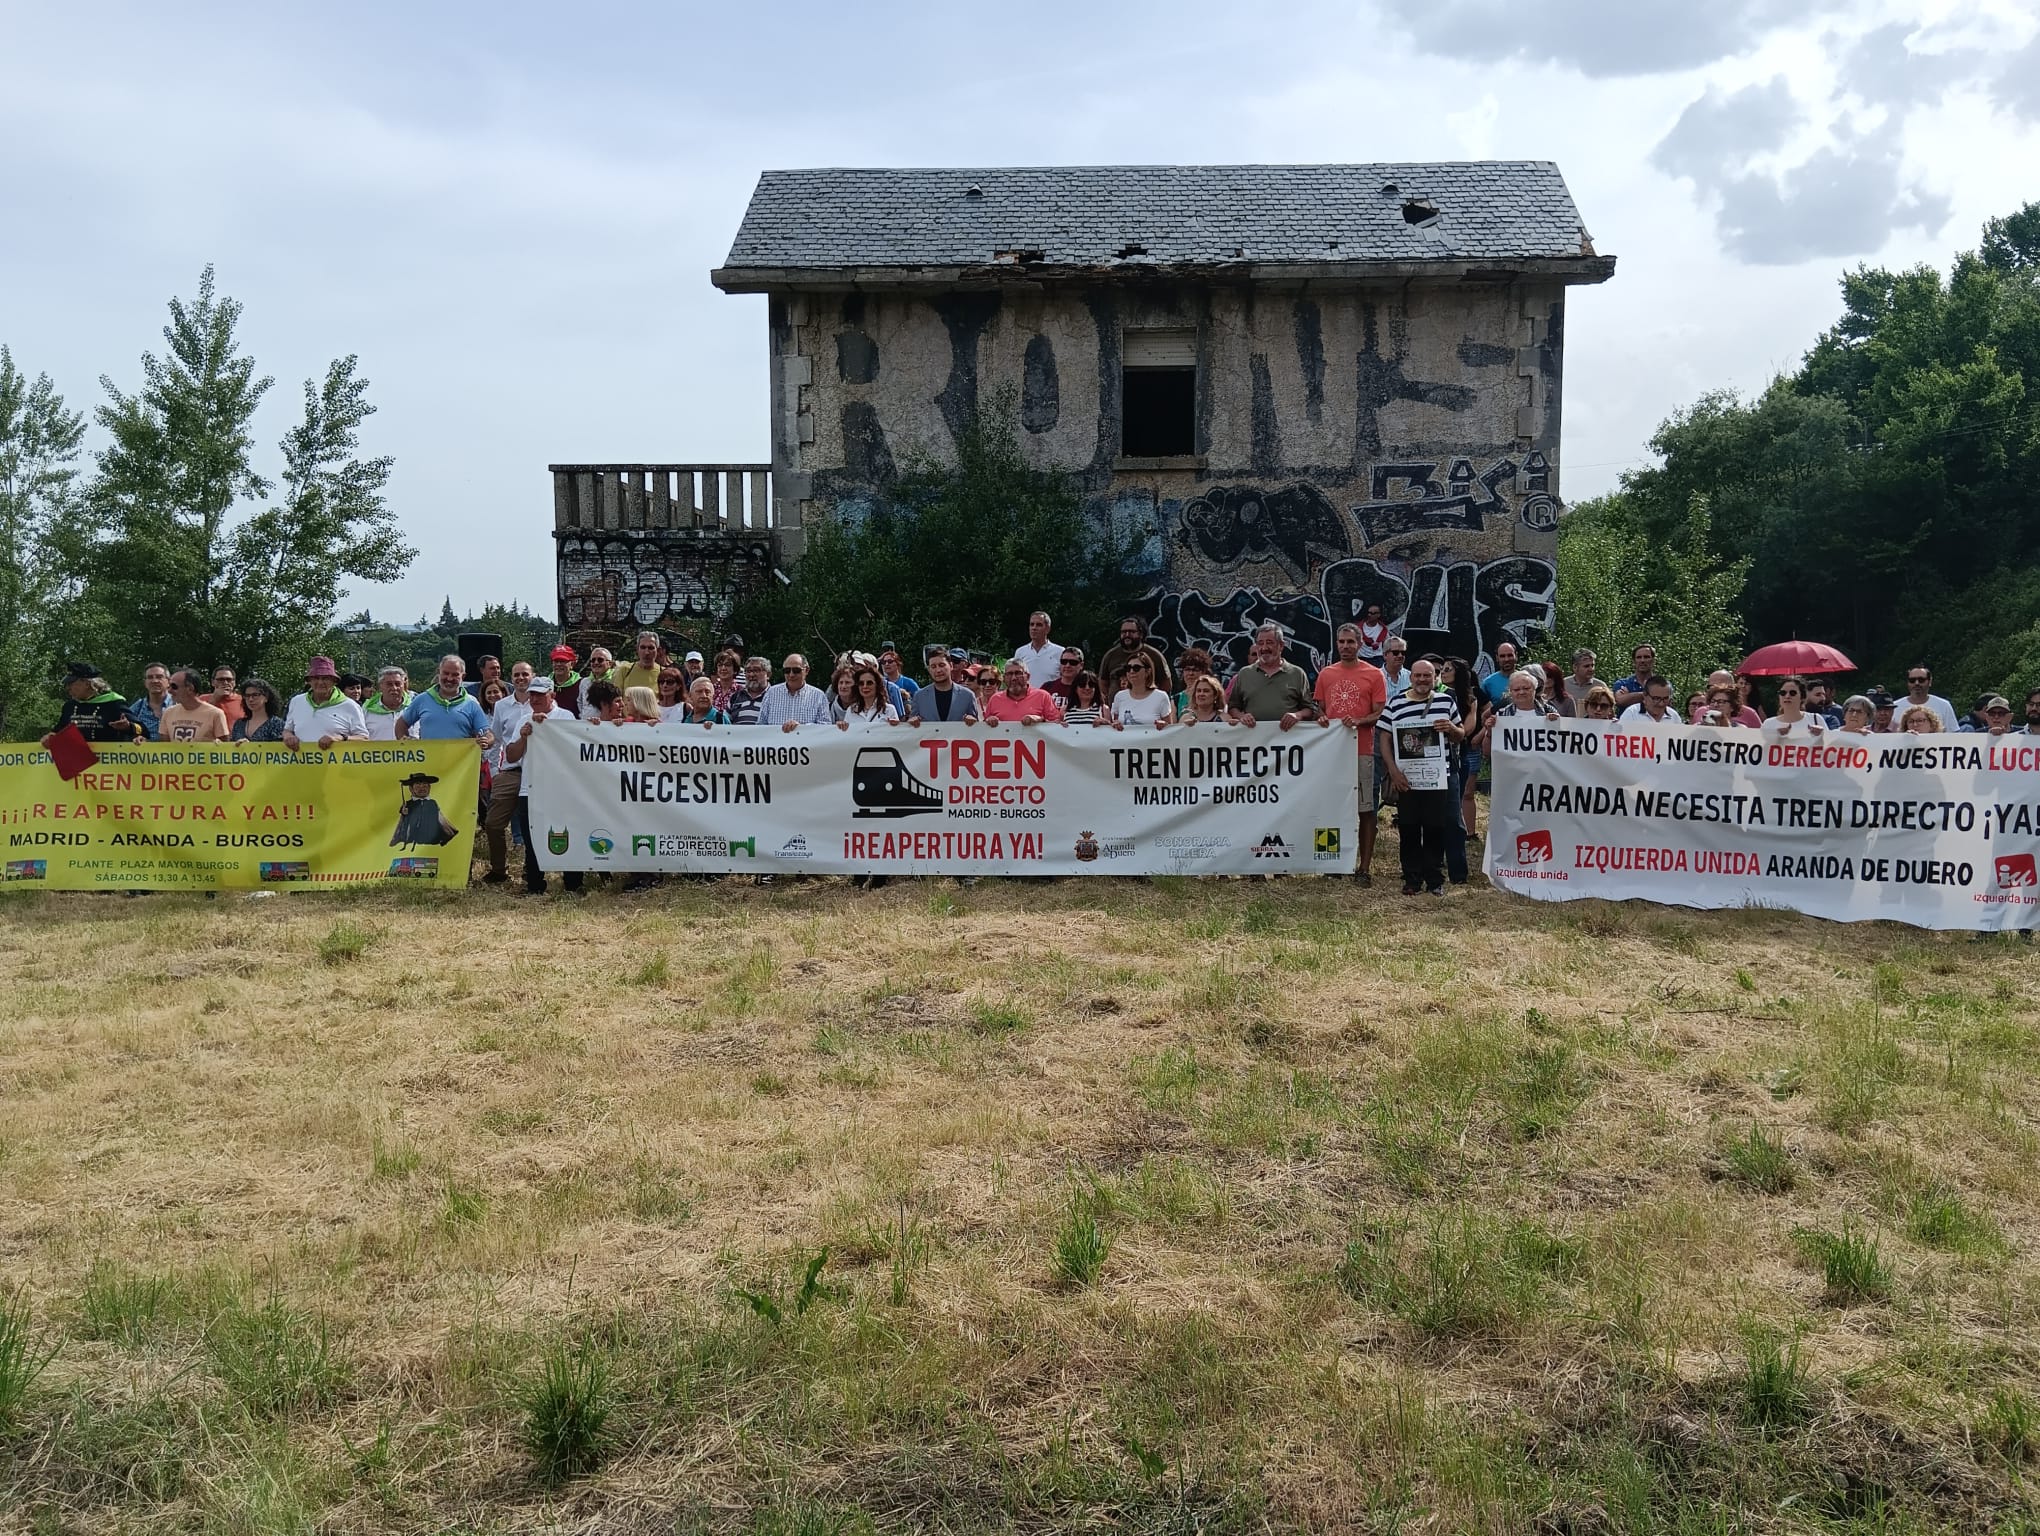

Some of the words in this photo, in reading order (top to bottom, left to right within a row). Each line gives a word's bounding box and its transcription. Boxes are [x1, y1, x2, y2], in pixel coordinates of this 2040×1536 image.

[187, 752, 206, 765] DE
[210, 751, 263, 766] BILBAO/
[266, 751, 324, 767] PASAJES
[327, 751, 340, 764] A
[342, 749, 426, 764] ALGECIRAS
[1503, 728, 1598, 755] NUESTRO
[1604, 734, 1661, 764] TREN,
[1668, 738, 1763, 766] NUESTRO
[1768, 744, 1873, 772] DERECHO,
[1879, 747, 1982, 770] NUESTRA
[919, 740, 1046, 779] TREN
[1109, 746, 1182, 779] TREN
[1189, 745, 1304, 778] DIRECTO
[73, 774, 131, 791] TREN
[141, 774, 245, 792] DIRECTO
[619, 770, 772, 804] NECESITAN
[948, 785, 1046, 804] DIRECTO
[243, 805, 315, 820] YA!!!
[948, 809, 990, 818] MADRID
[1001, 809, 1046, 818] BURGOS
[1519, 783, 1628, 817] ARANDA
[1635, 789, 1765, 825] NECESITA
[1773, 797, 1843, 829] TREN
[1851, 799, 1975, 832] DIRECTO
[1984, 803, 2040, 840] ¡YA!
[10, 832, 90, 846] MADRID
[110, 833, 195, 847] ARANDA
[215, 833, 304, 847] BURGOS
[660, 841, 673, 850] FC
[675, 841, 727, 850] DIRECTO
[844, 832, 1003, 860] ¡REAPERTURA
[1008, 832, 1043, 860] YA!
[1103, 842, 1136, 852] Aranda
[1110, 850, 1136, 859] Duero
[69, 860, 113, 868] PLANTE
[121, 860, 154, 869] PLAZA
[158, 860, 194, 869] MAYOR
[196, 861, 239, 869] BURGOS
[1574, 845, 1688, 874] IZQUIERDA
[1695, 850, 1761, 876] UNIDA
[1766, 854, 1854, 880] ARANDA
[1861, 858, 1889, 882] DE
[1895, 859, 1974, 886] DUERO
[95, 872, 148, 881] SÁBADOS
[1496, 867, 1538, 879] izquierda
[1541, 870, 1569, 881] unida
[1974, 893, 2021, 904] izquierda
